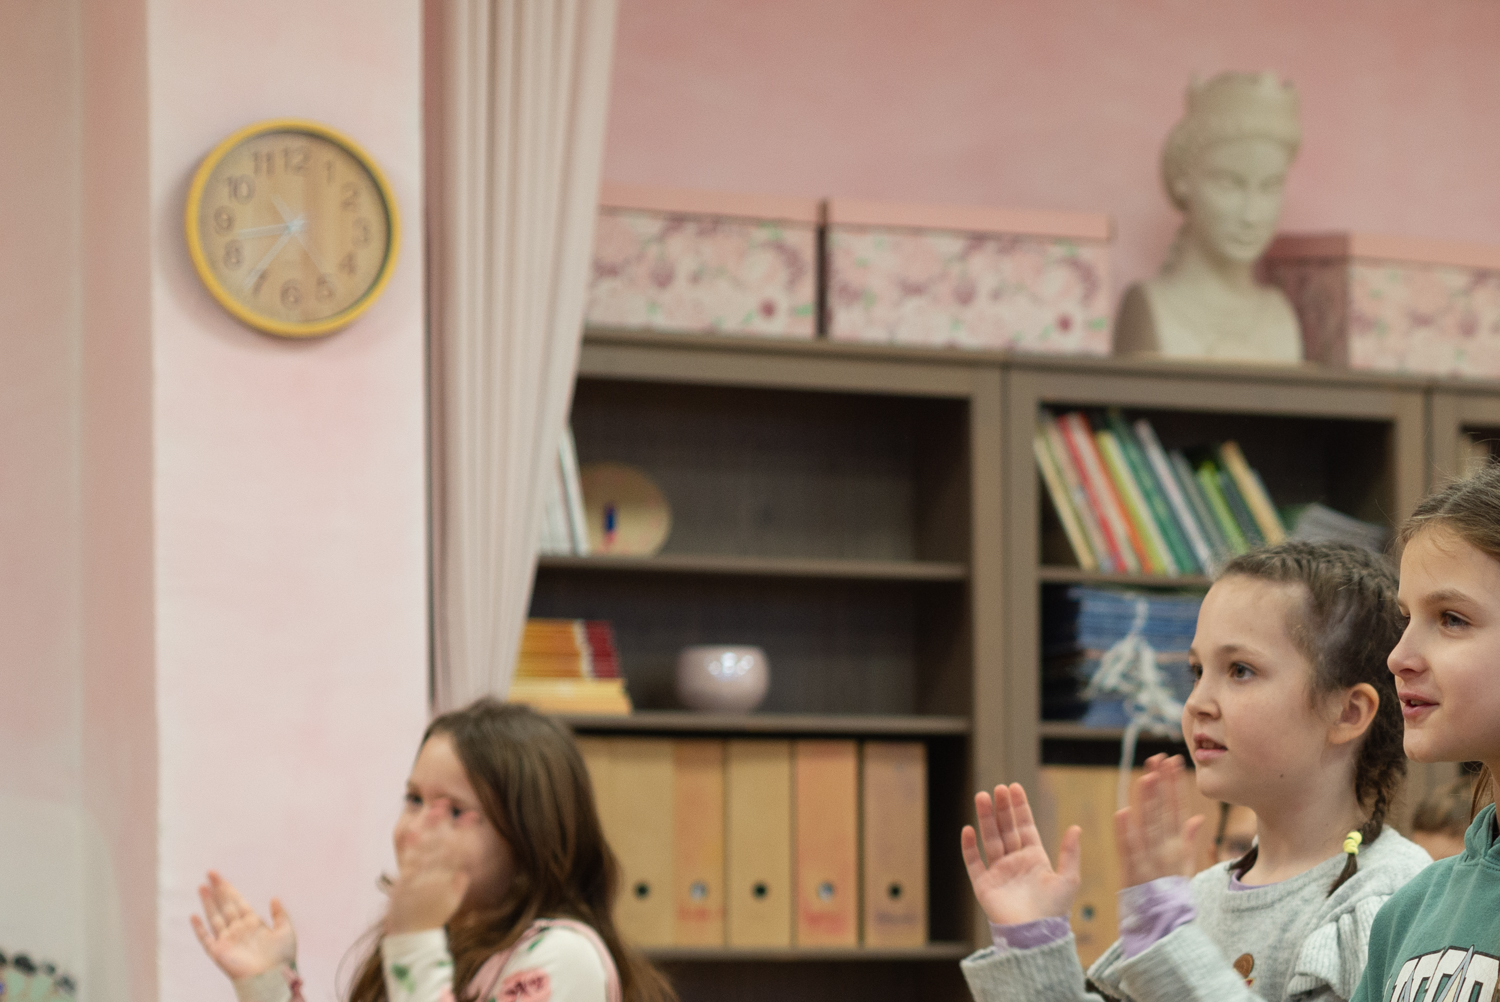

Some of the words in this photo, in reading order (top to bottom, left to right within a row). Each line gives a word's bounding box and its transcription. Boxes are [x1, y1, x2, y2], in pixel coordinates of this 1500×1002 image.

[252, 150, 276, 179] 11
[282, 146, 312, 176] 12
[226, 174, 256, 206] 10
[340, 182, 361, 212] 2
